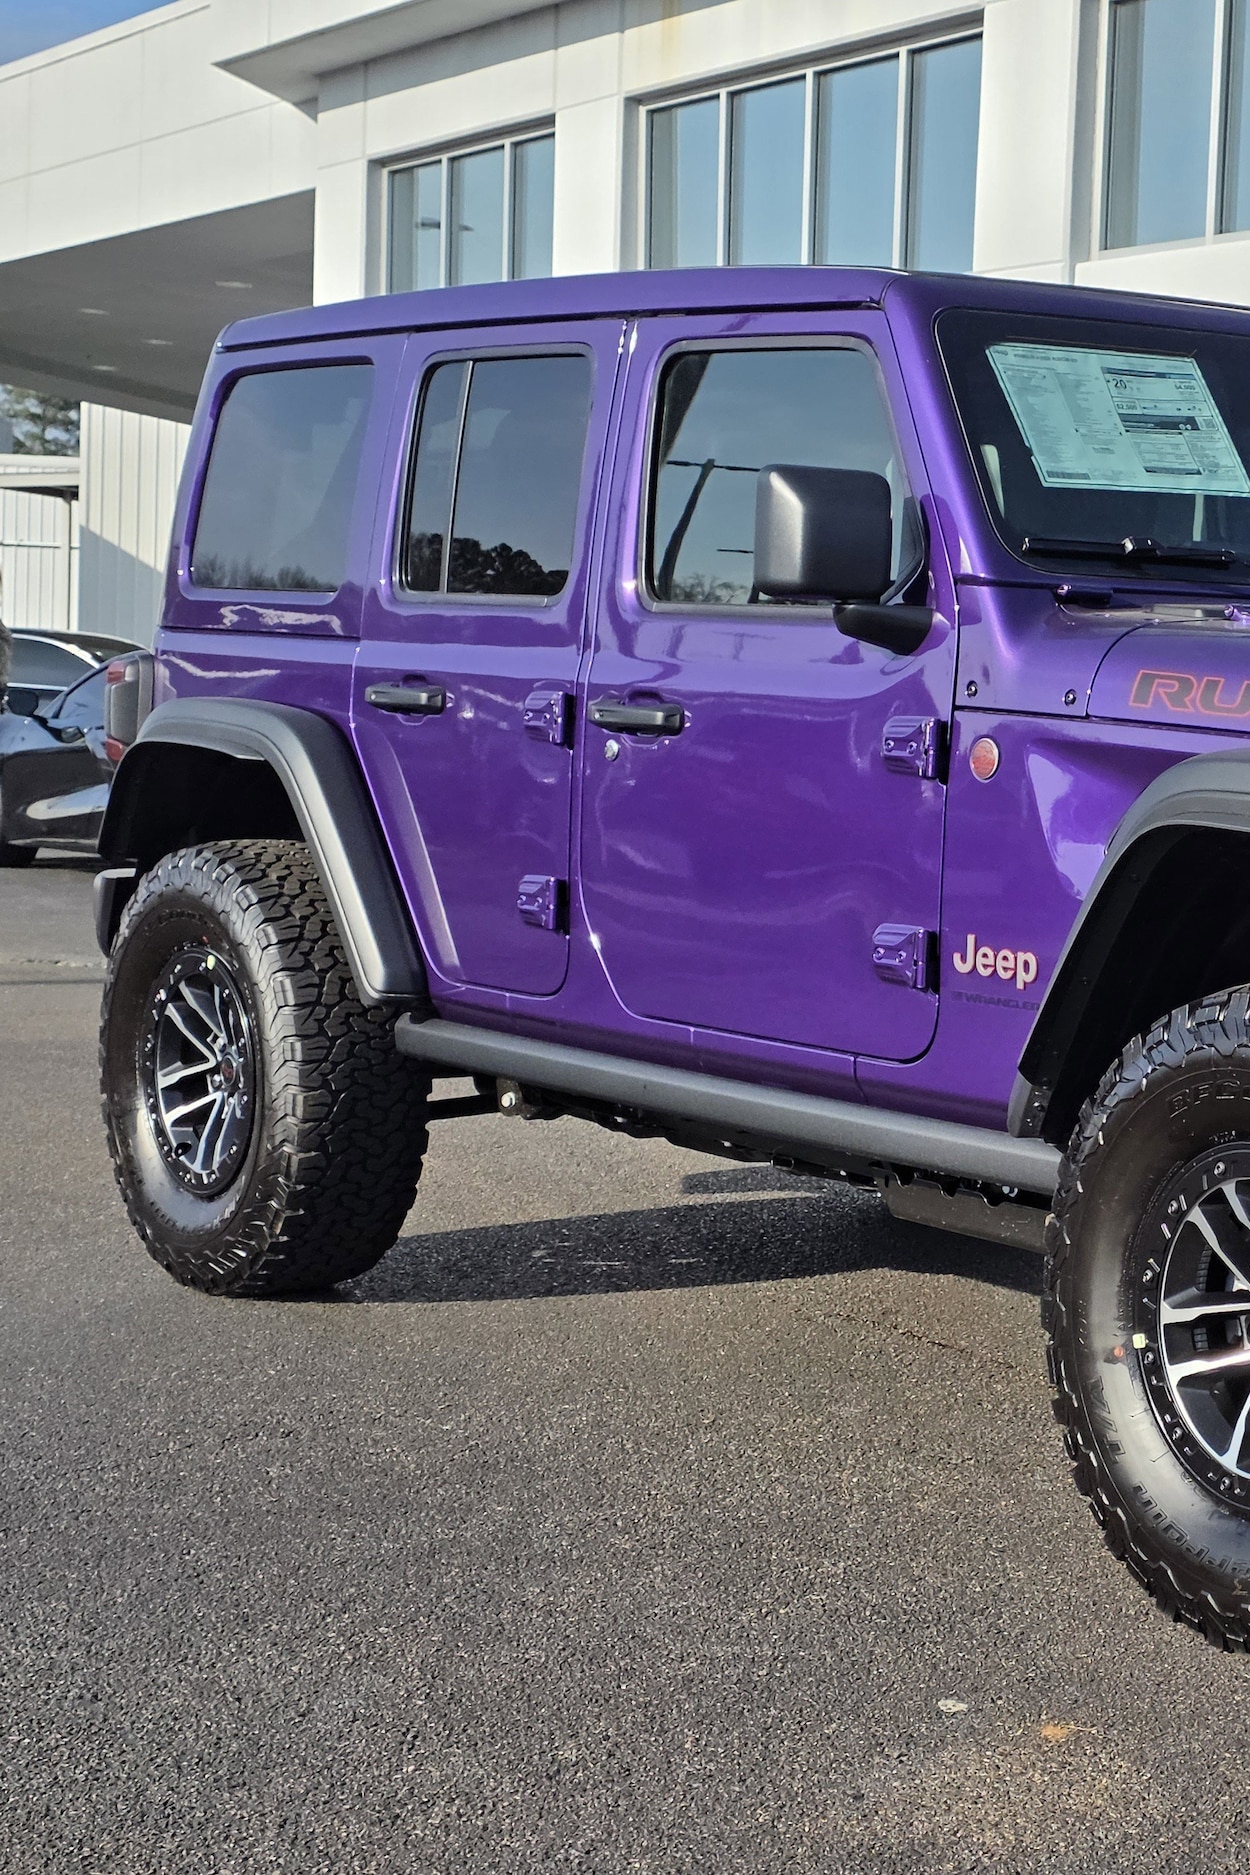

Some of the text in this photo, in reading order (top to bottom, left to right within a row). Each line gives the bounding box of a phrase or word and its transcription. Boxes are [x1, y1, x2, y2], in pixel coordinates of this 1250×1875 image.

[1112, 378, 1127, 390] 20
[953, 934, 1038, 990] Jeep
[964, 992, 1040, 1011] WRANGLER
